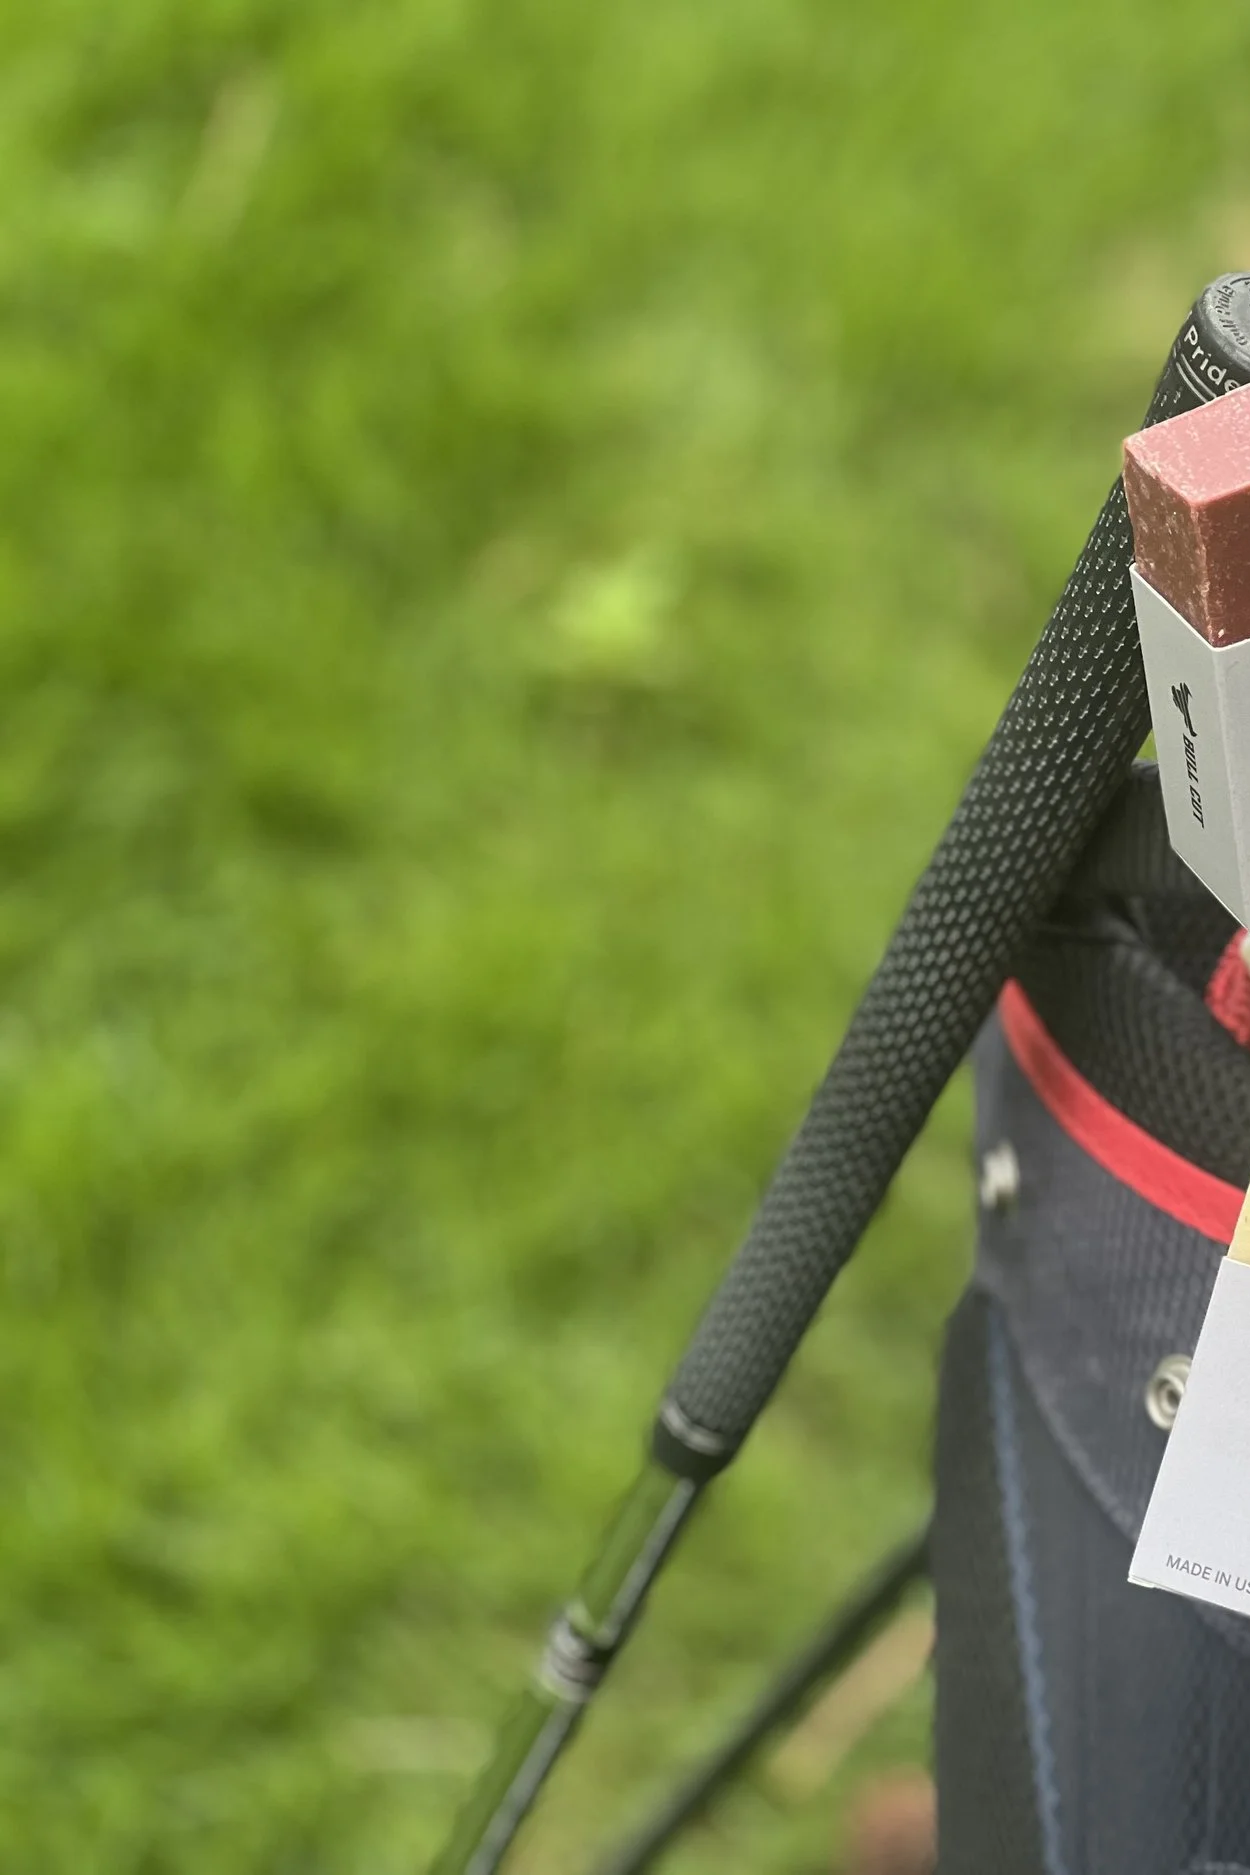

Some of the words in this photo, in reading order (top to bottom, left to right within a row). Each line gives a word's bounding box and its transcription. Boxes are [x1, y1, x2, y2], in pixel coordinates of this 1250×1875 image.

[1184, 325, 1241, 392] Pride
[1183, 733, 1199, 784] BULL
[1189, 785, 1204, 829] CUT
[1167, 1556, 1212, 1579] MADE
[1215, 1572, 1231, 1586] IN
